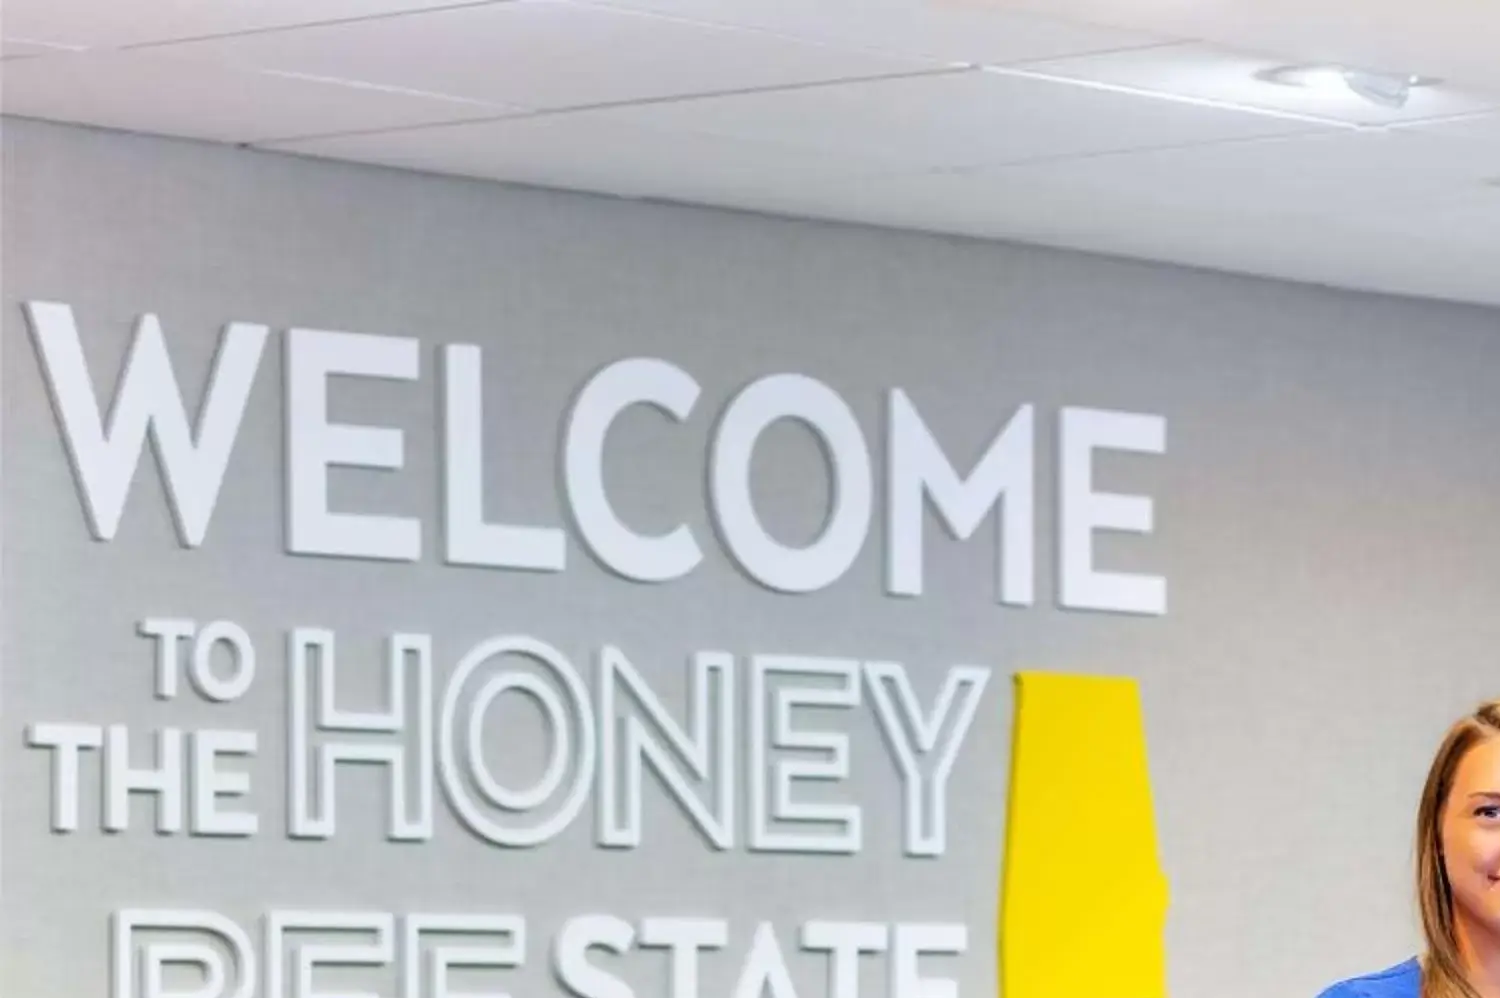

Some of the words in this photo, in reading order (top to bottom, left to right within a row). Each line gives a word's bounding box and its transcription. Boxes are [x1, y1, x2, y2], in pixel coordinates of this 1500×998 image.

[26, 300, 1167, 615] WELCOME
[30, 723, 258, 835] THE
[288, 628, 990, 857] HONEY
[142, 618, 256, 701] TO
